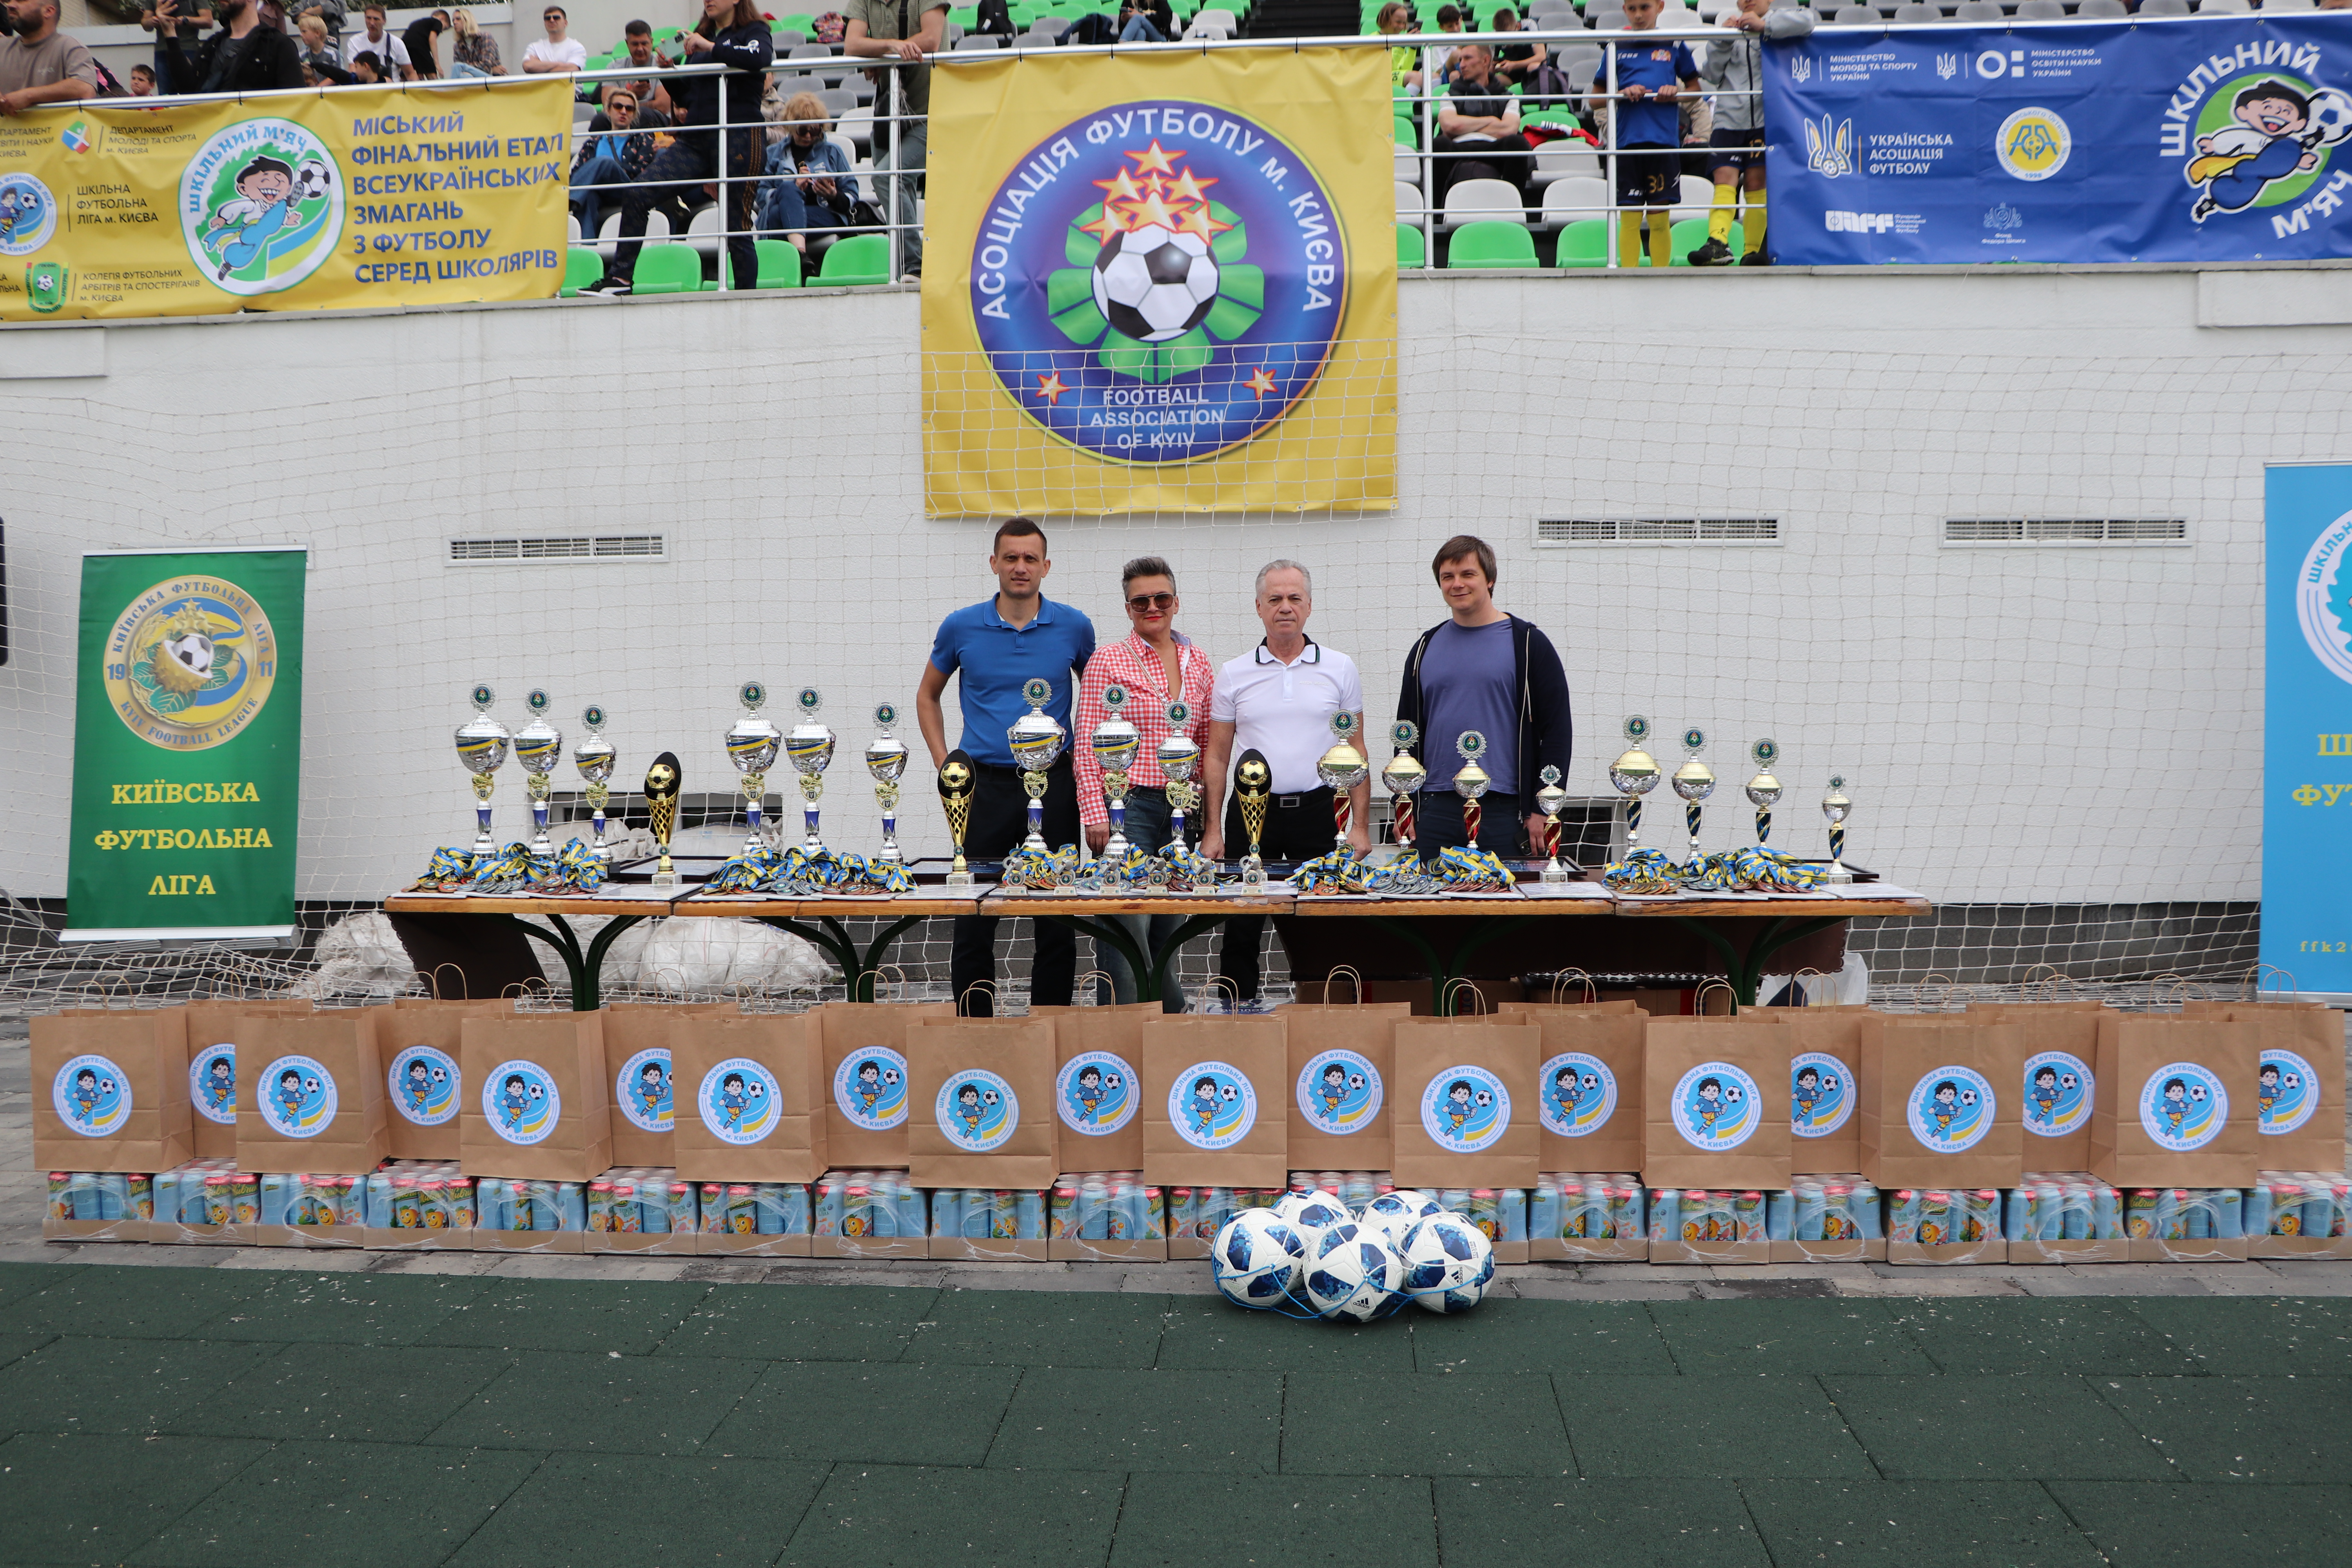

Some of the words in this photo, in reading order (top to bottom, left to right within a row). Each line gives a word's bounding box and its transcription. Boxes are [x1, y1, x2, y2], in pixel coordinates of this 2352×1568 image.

[1830, 53, 1895, 63] МІНІСТЕРСТВО
[2031, 49, 2094, 57] МІНІСТЕРСТВО
[1830, 64, 1866, 73] МОЛОДІ
[2070, 58, 2102, 67] НАУКИ
[1830, 72, 1870, 82] УКРАЇНИ
[2033, 69, 2071, 78] УКРАЇНИ
[2160, 40, 2321, 157] ШКІЛЬНИЙ
[110, 125, 174, 134] ДЕПАРТАМЕНТ
[354, 111, 463, 136] МІСЬКИЙ
[27, 137, 54, 145] НАУКИ
[109, 137, 148, 145] МОЛОДІ
[163, 134, 197, 143] СПОРТА
[1869, 132, 1953, 147] УКРАЇНСЬКА
[352, 136, 499, 165] ФІНАЛЬНИЙ
[508, 133, 563, 156] ЕТАП
[1869, 148, 1943, 161] АСОЦІАЦІЯ
[189, 124, 258, 213] ШКІЛЬНИЙ
[1869, 162, 1931, 175] ФУТБОЛУ
[354, 162, 561, 195] ВСЕУКРАЇНСЬКИХ
[1647, 173, 1664, 194] 30
[77, 184, 131, 195] ШКІЛЬНА
[77, 198, 147, 209] ФУТБОЛЬНА
[354, 201, 463, 224] ЗМАГАНЬ
[78, 214, 102, 224] ЛІГА
[119, 213, 158, 223] КИЄВА
[978, 136, 1080, 319] АСОЦІАЦІЯ
[1085, 108, 1264, 157] ФУТБОЛУ
[1289, 190, 1334, 312] КИЄВА
[354, 234, 365, 254] З
[373, 229, 491, 252] ФУТБОЛУ
[123, 269, 183, 279] ФУТБОЛЬНИХ
[355, 261, 430, 284] СЕРЕД
[437, 250, 557, 279] ШКОЛЯРІВ
[81, 283, 121, 291] АРБІТРІВ
[136, 280, 201, 290] СПОСТЕРІГАЧІВ
[1103, 388, 1209, 406] FOOTBALL
[1089, 409, 1224, 427] ASSOCIATION
[1117, 433, 1142, 449] OF
[1150, 432, 1196, 448] KYIV
[113, 591, 165, 653] КИЇВСЬКА
[171, 582, 251, 615] ФУТБОЛЬНА
[253, 623, 269, 653] ЛІГА
[107, 663, 126, 680] 19
[258, 661, 273, 677] 11
[120, 701, 145, 727] KYIV
[148, 726, 213, 745] FOOTBALL
[217, 698, 258, 737] LEAGUE
[111, 779, 260, 804] КИЇВСЬКА
[94, 828, 273, 850] ФУТБОЛЬНА
[148, 875, 216, 895] ЛІГА
[392, 1052, 410, 1079] ШКІЛЬНА
[410, 1048, 450, 1065] ФУТБОЛЬНА
[450, 1064, 460, 1081] ЛІГА
[57, 1060, 79, 1087] ШКІЛЬНА
[80, 1058, 120, 1077] ФУТБОЛЬНА
[119, 1076, 128, 1094] ЛІГА
[701, 1067, 725, 1095] ШКІЛЬНА
[726, 1061, 768, 1080] ФУТБОЛЬНА
[768, 1079, 778, 1096] ЛІГА
[1172, 1070, 1197, 1100] ШКІЛЬНА
[1198, 1064, 1243, 1083] ФУТБОЛЬНА
[1242, 1082, 1252, 1100] ЛІГА
[1675, 1070, 1700, 1100] ШКІЛЬНА
[1702, 1065, 1748, 1083] ФУТБОЛЬНА
[1747, 1083, 1758, 1101] ЛІГА
[2143, 1072, 2165, 1103] ШКІЛЬНА
[2167, 1065, 2212, 1082] ФУТБОЛЬНА
[2211, 1082, 2223, 1098] ЛІГА
[938, 1079, 958, 1108] ШКІЛЬНА
[958, 1072, 1002, 1088] ФУТБОЛЬНА
[1001, 1085, 1013, 1102] ЛІГА
[1425, 1072, 1453, 1100] ШКІЛЬНА
[1454, 1068, 1499, 1089] ФУТБОЛЬНА
[1497, 1088, 1507, 1106] ЛІГА
[1912, 1074, 1937, 1103] ШКІЛЬНА
[1939, 1069, 1984, 1086] ФУТБОЛЬНА
[1982, 1086, 1992, 1103] ЛІГА
[975, 1138, 1000, 1148] КИЄВА
[1707, 1139, 1734, 1148] КИЄВА
[1941, 1142, 1967, 1150] КИЄВА
[2176, 1138, 2202, 1148] КИЄВА
